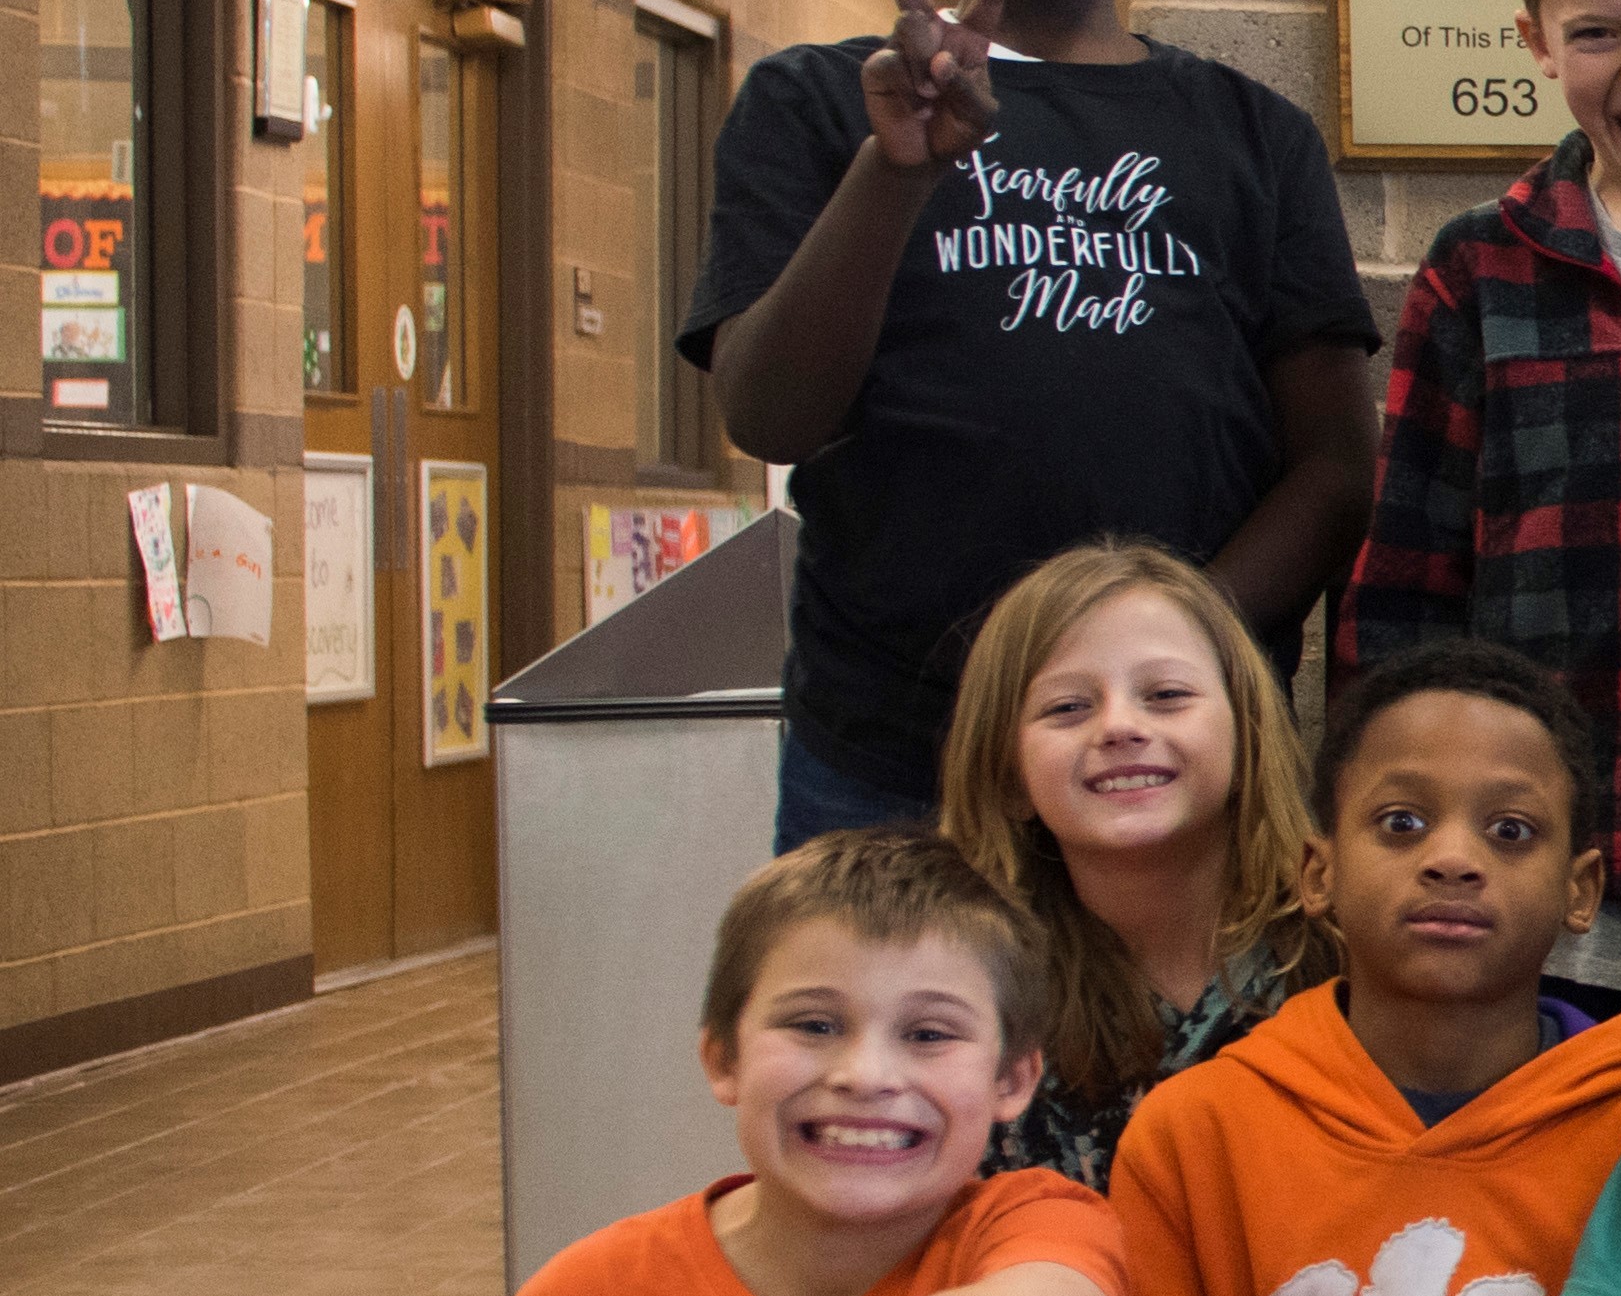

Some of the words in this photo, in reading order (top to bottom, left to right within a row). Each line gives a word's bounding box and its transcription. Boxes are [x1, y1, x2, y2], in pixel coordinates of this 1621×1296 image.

[1402, 26, 1431, 48] Of
[1440, 26, 1491, 49] This
[1452, 78, 1538, 117] 653
[957, 132, 1173, 233] Fearfully
[43, 217, 124, 270] OF
[1056, 214, 1086, 228] AND
[1001, 268, 1155, 334] Made
